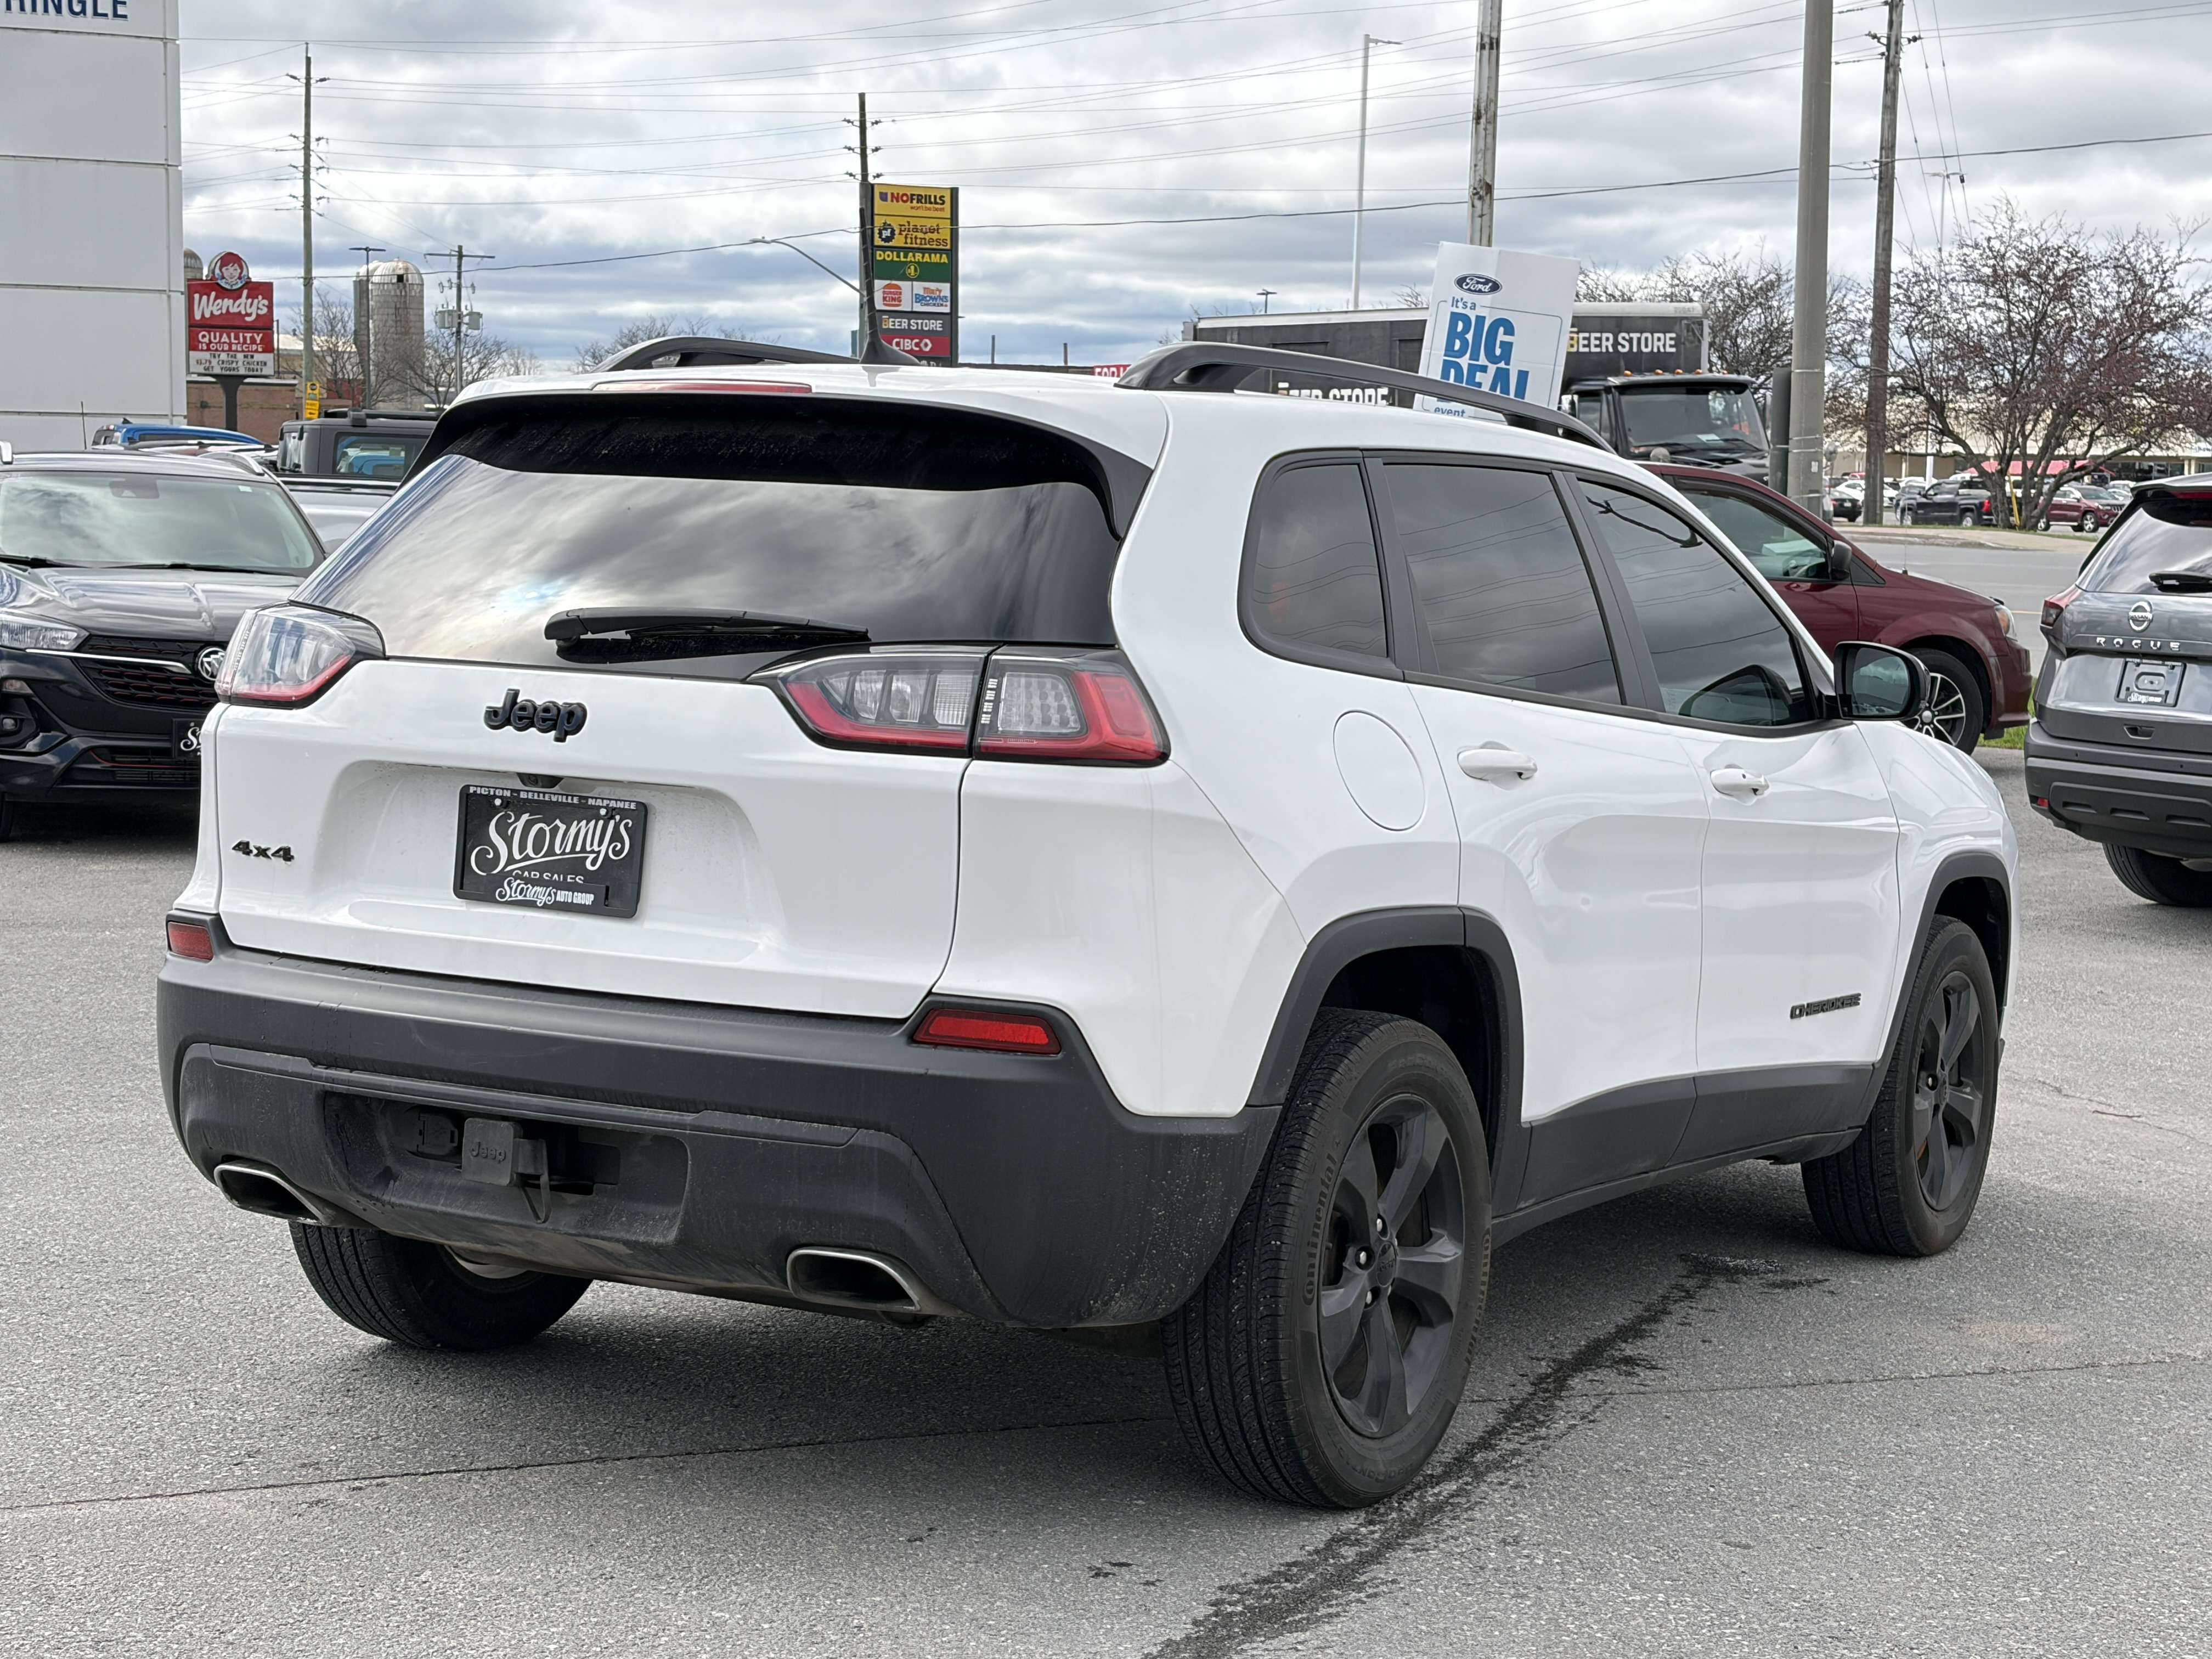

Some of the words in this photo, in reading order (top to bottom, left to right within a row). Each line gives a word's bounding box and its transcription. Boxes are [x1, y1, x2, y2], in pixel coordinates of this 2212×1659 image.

[898, 221, 940, 236] planet
[904, 234, 948, 247] fitness
[876, 251, 948, 263] DOLLARAMA
[1462, 276, 1492, 292] Ford
[194, 290, 268, 321] Wendy's
[1451, 296, 1467, 309] It's
[1469, 302, 1476, 311] a
[882, 316, 908, 329] BEER
[910, 319, 943, 331] STORE
[199, 331, 263, 343] QUALITY
[893, 338, 920, 351] CIBC
[1443, 311, 1515, 366] BIG
[1567, 328, 1613, 352] BEER
[1618, 332, 1677, 353] STORE
[2096, 637, 2181, 651] ROGUE
[484, 689, 588, 743] Jeep
[469, 786, 511, 797] PICTON
[520, 791, 579, 804] BELLEVILLE
[588, 798, 637, 810] NAPANEE
[232, 839, 295, 862] 4x4
[471, 811, 633, 876] Stormy's
[495, 877, 556, 906] Stormy's
[556, 890, 572, 903] AUTO
[573, 891, 594, 905] GROUP
[1790, 992, 1861, 1019] CHEROKEE
[470, 1141, 506, 1164] Jeep
